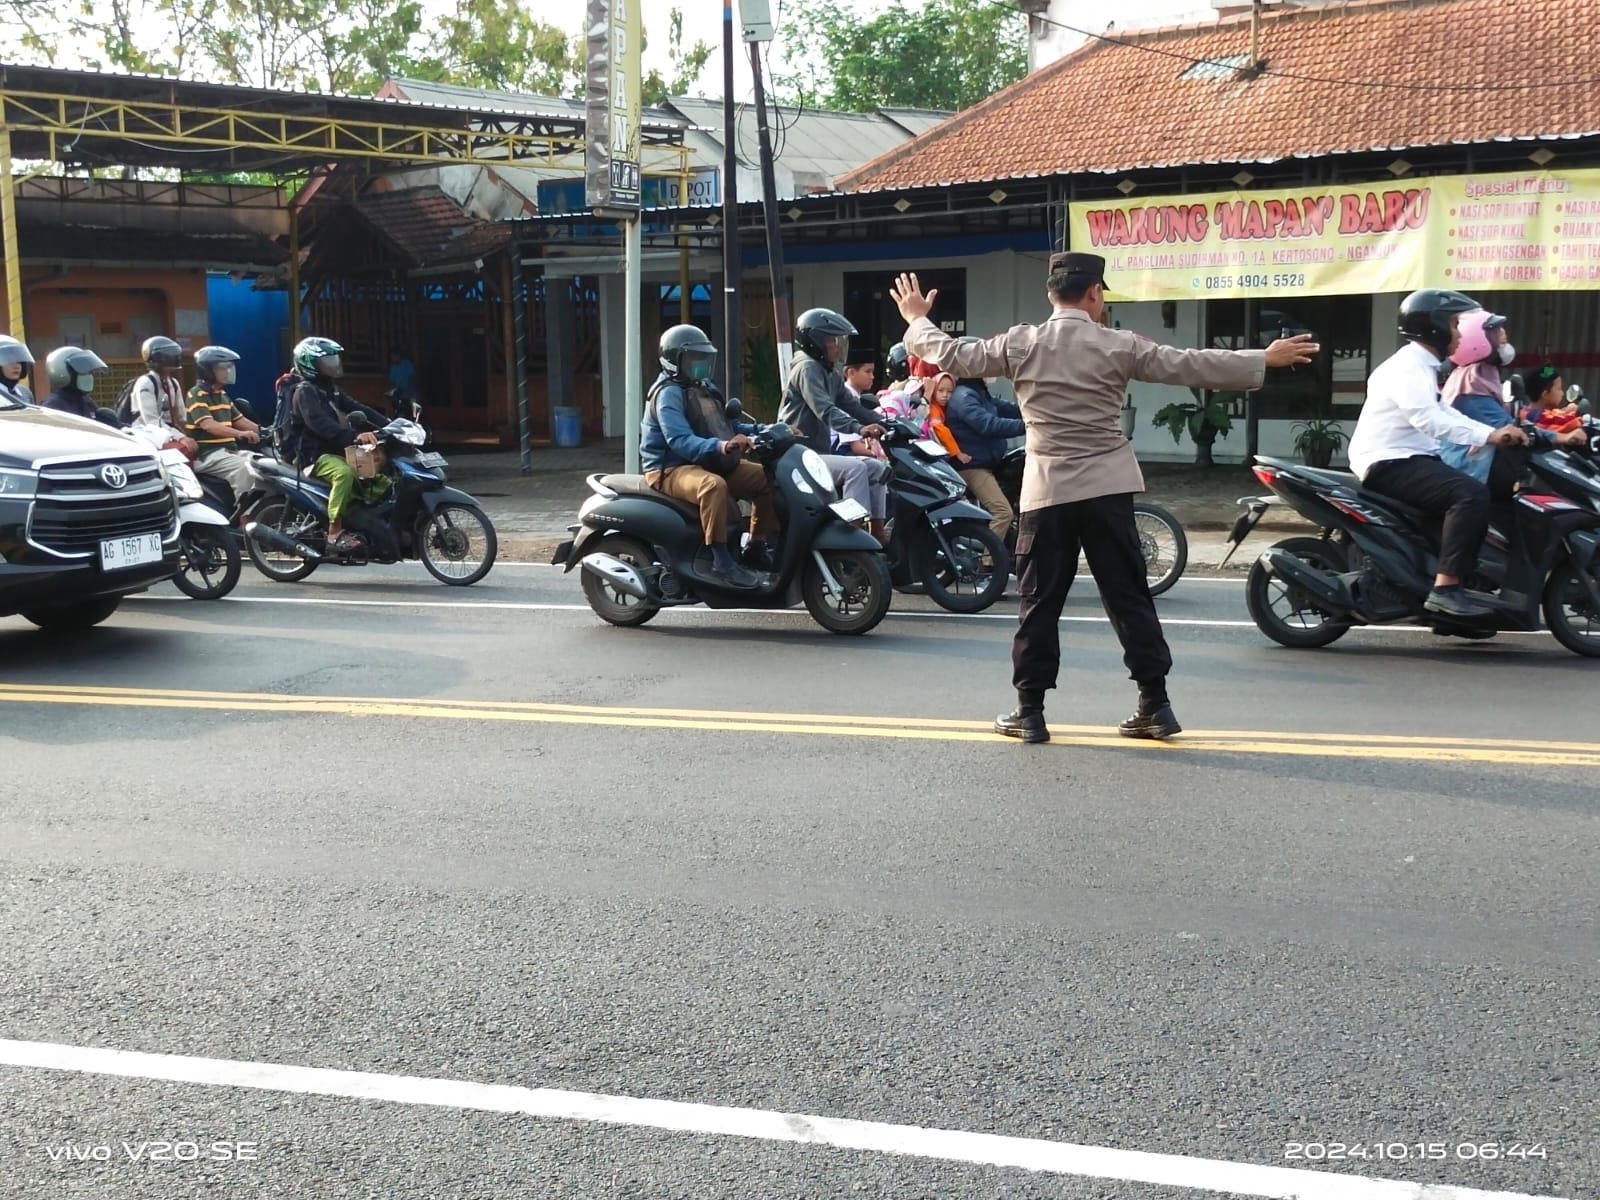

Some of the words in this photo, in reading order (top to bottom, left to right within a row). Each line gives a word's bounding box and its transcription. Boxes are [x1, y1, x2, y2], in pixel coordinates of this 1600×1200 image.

[670, 181, 712, 199] DPOT
[1464, 179, 1519, 199] Spesial
[1459, 204, 1481, 218] NASI
[1564, 200, 1588, 215] NASI
[1086, 203, 1210, 248] WARUNG
[1338, 187, 1432, 235] BARU
[1458, 225, 1479, 239] NASI
[1127, 254, 1175, 268] PANGLIMA
[1178, 252, 1229, 267] SUDIRMAN
[1253, 250, 1266, 263] 1A
[1272, 247, 1335, 263] KERTOSONO
[1457, 246, 1477, 260] NASI
[1503, 265, 1543, 280] GORENG
[1205, 275, 1233, 289] 0855
[1237, 274, 1268, 288] 4904
[1273, 273, 1305, 287] 5528
[103, 542, 115, 560] AG
[121, 538, 142, 556] 1567
[149, 535, 160, 552] XC
